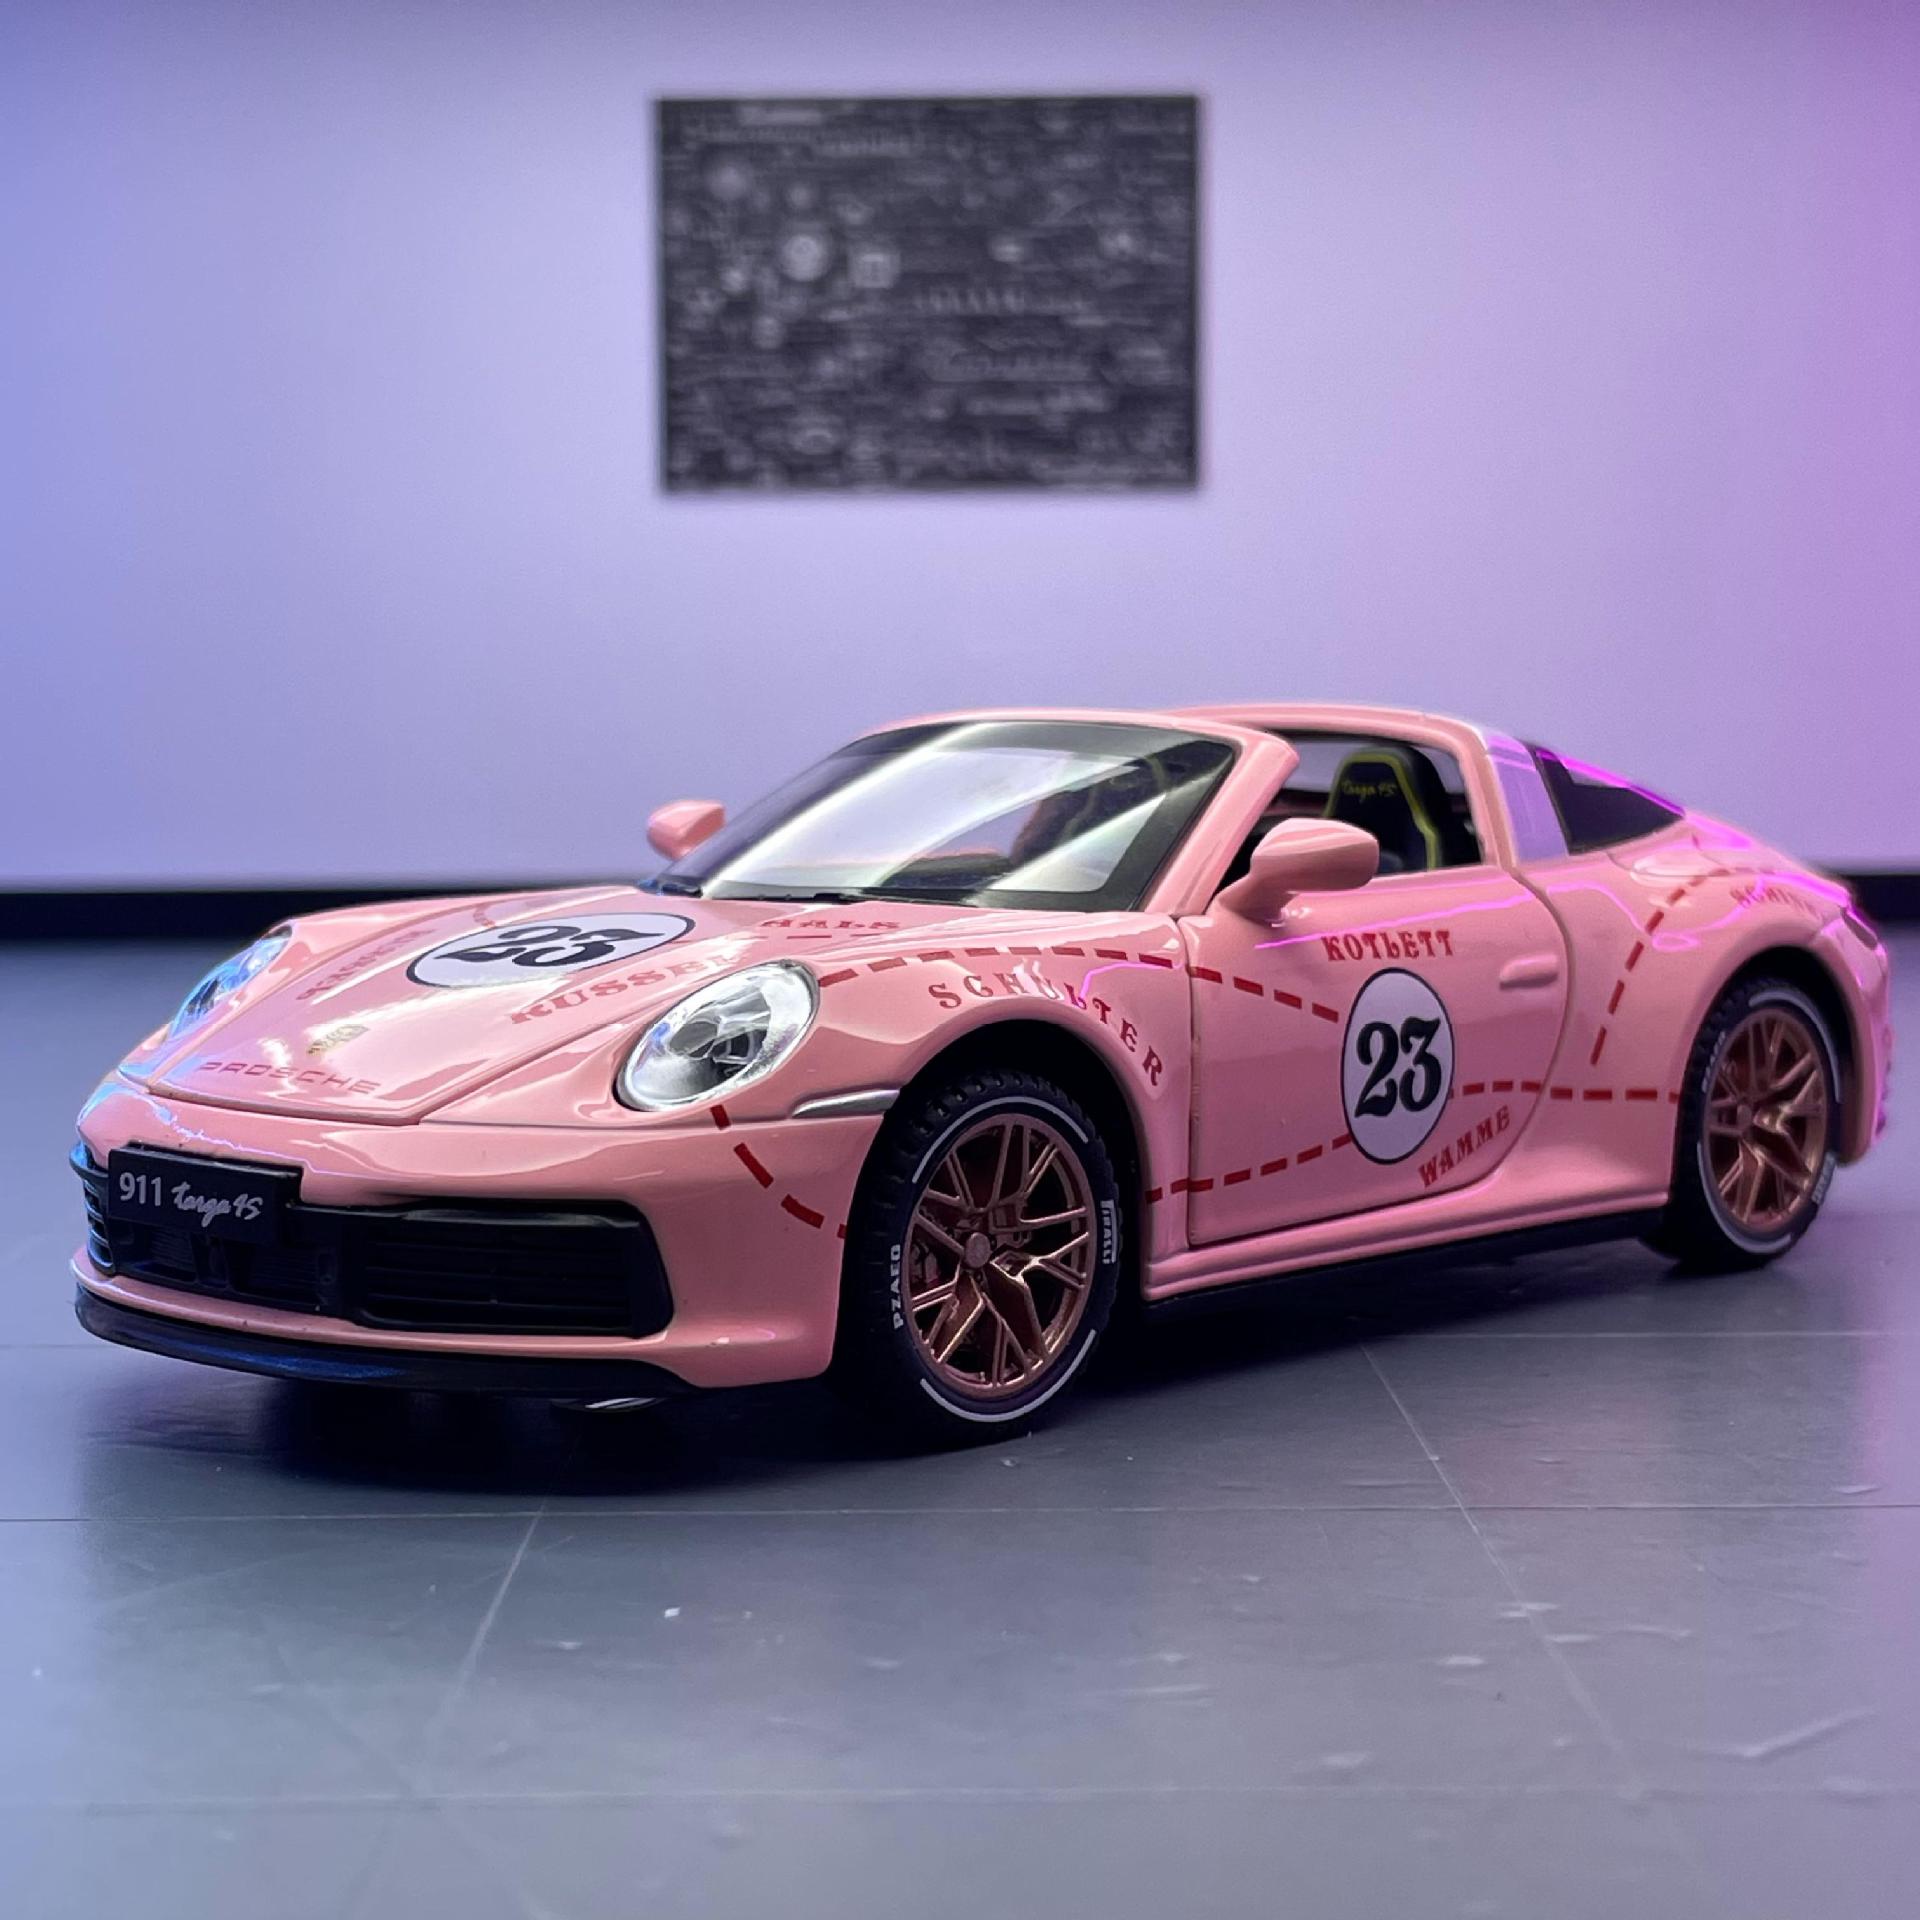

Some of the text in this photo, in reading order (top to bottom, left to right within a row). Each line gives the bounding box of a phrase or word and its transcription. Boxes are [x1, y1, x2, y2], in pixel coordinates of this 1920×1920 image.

[433, 926, 665, 966] 23
[1321, 929, 1454, 962] KOTLETT
[928, 973, 1164, 1086] SCHULTER
[1354, 1016, 1442, 1118] 23
[1418, 1106, 1511, 1188] WAMME
[119, 1172, 162, 1207] 911
